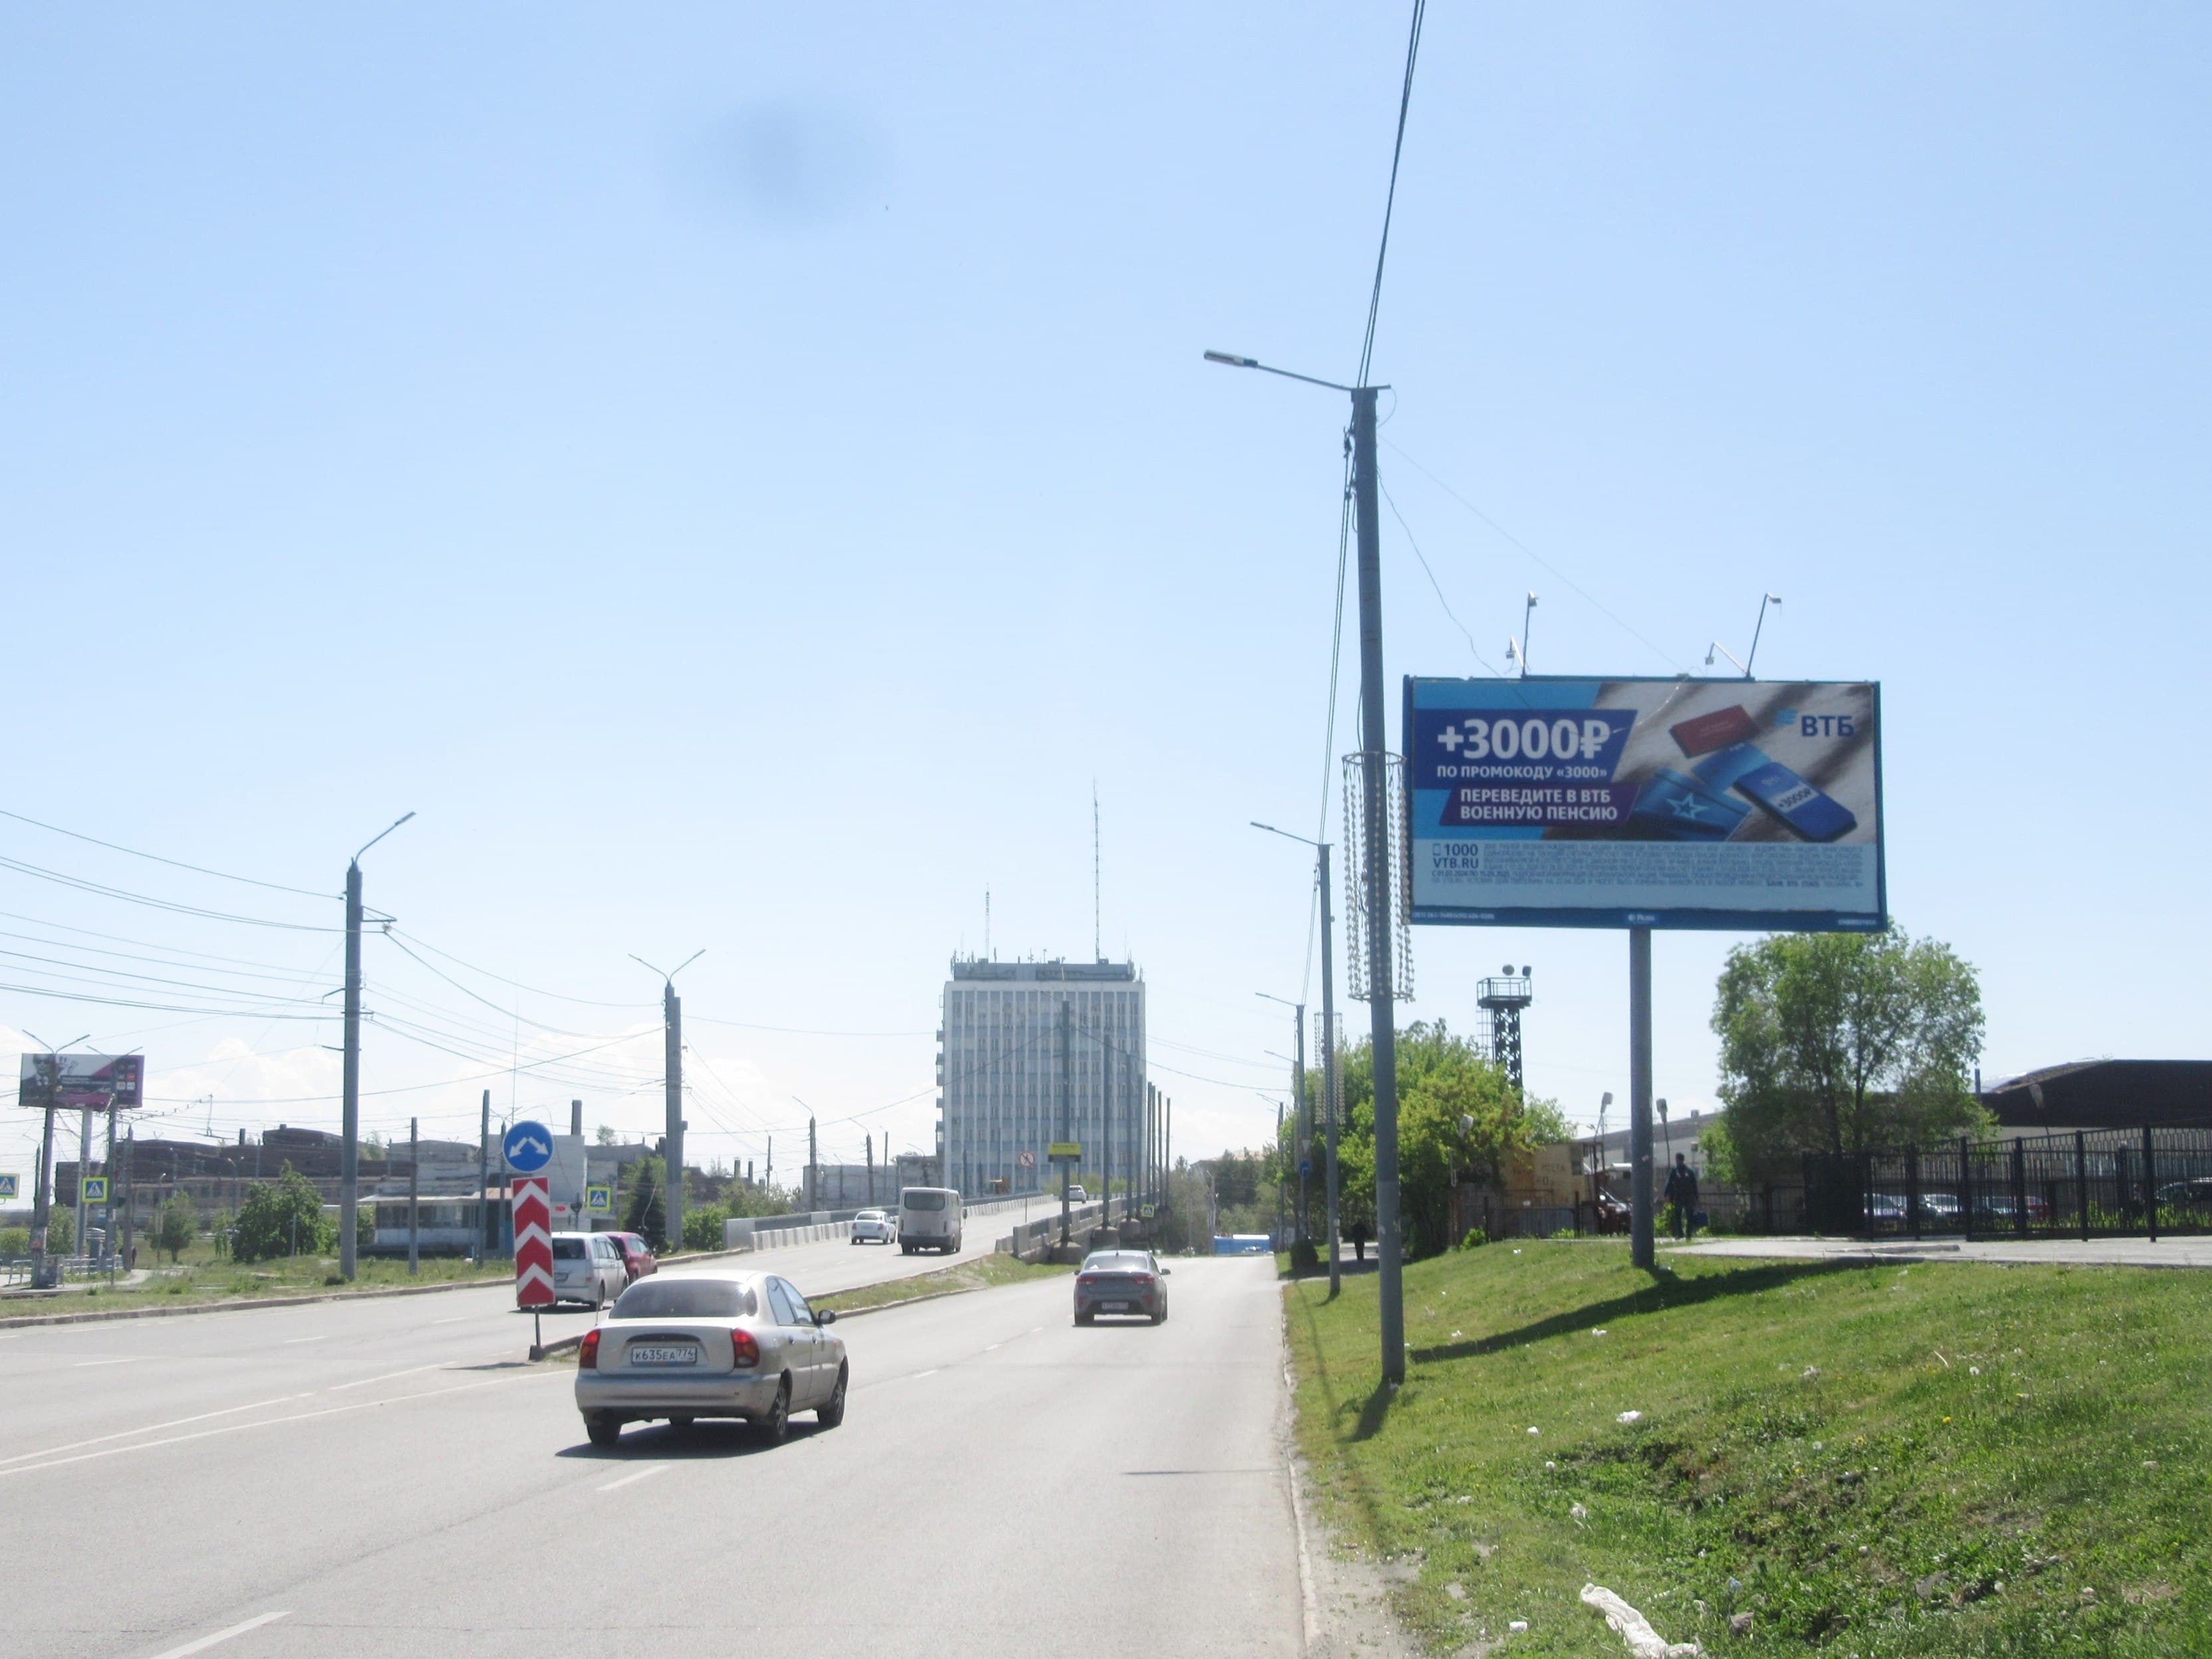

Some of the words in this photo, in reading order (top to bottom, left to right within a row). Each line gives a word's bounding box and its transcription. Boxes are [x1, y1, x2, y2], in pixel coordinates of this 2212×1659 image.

[1801, 716, 1855, 737] ВТБ
[1437, 766, 1457, 777] ПО
[1461, 765, 1554, 780] ПРОМОКОДУ
[1557, 766, 1607, 778] «3000»
[1460, 789, 1562, 805] ПЕРЕВЕДИТЕ
[1566, 790, 1577, 803] В
[1581, 790, 1611, 803] ВТБ
[1460, 806, 1542, 820] ВОЕННУЮ
[1547, 806, 1618, 820] ПЕНСИЮ
[1444, 844, 1478, 856] 1000
[1433, 858, 1478, 869] VTB.RU
